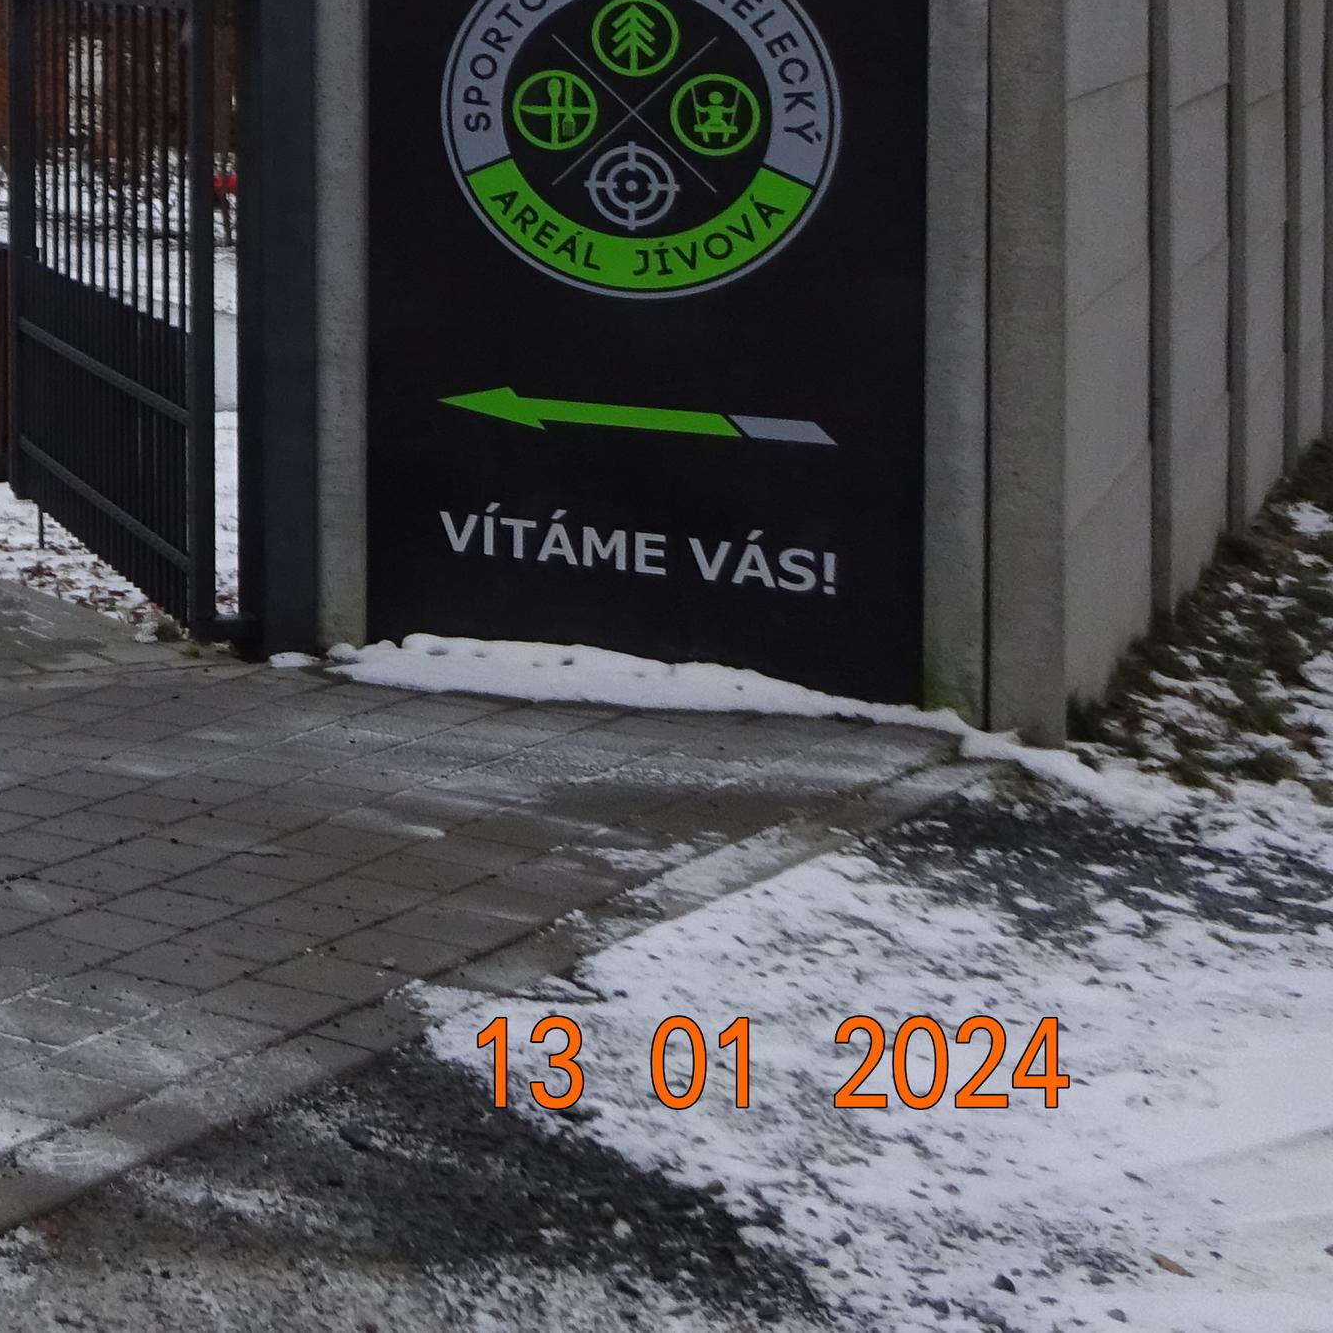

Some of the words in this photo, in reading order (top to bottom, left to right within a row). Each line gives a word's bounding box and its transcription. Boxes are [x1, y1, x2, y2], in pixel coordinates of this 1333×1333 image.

[490, 189, 601, 272] AREÁL
[632, 194, 786, 276] JÍVOVÁ
[439, 502, 667, 576] VÍTÁME
[688, 529, 838, 596] VÁS!
